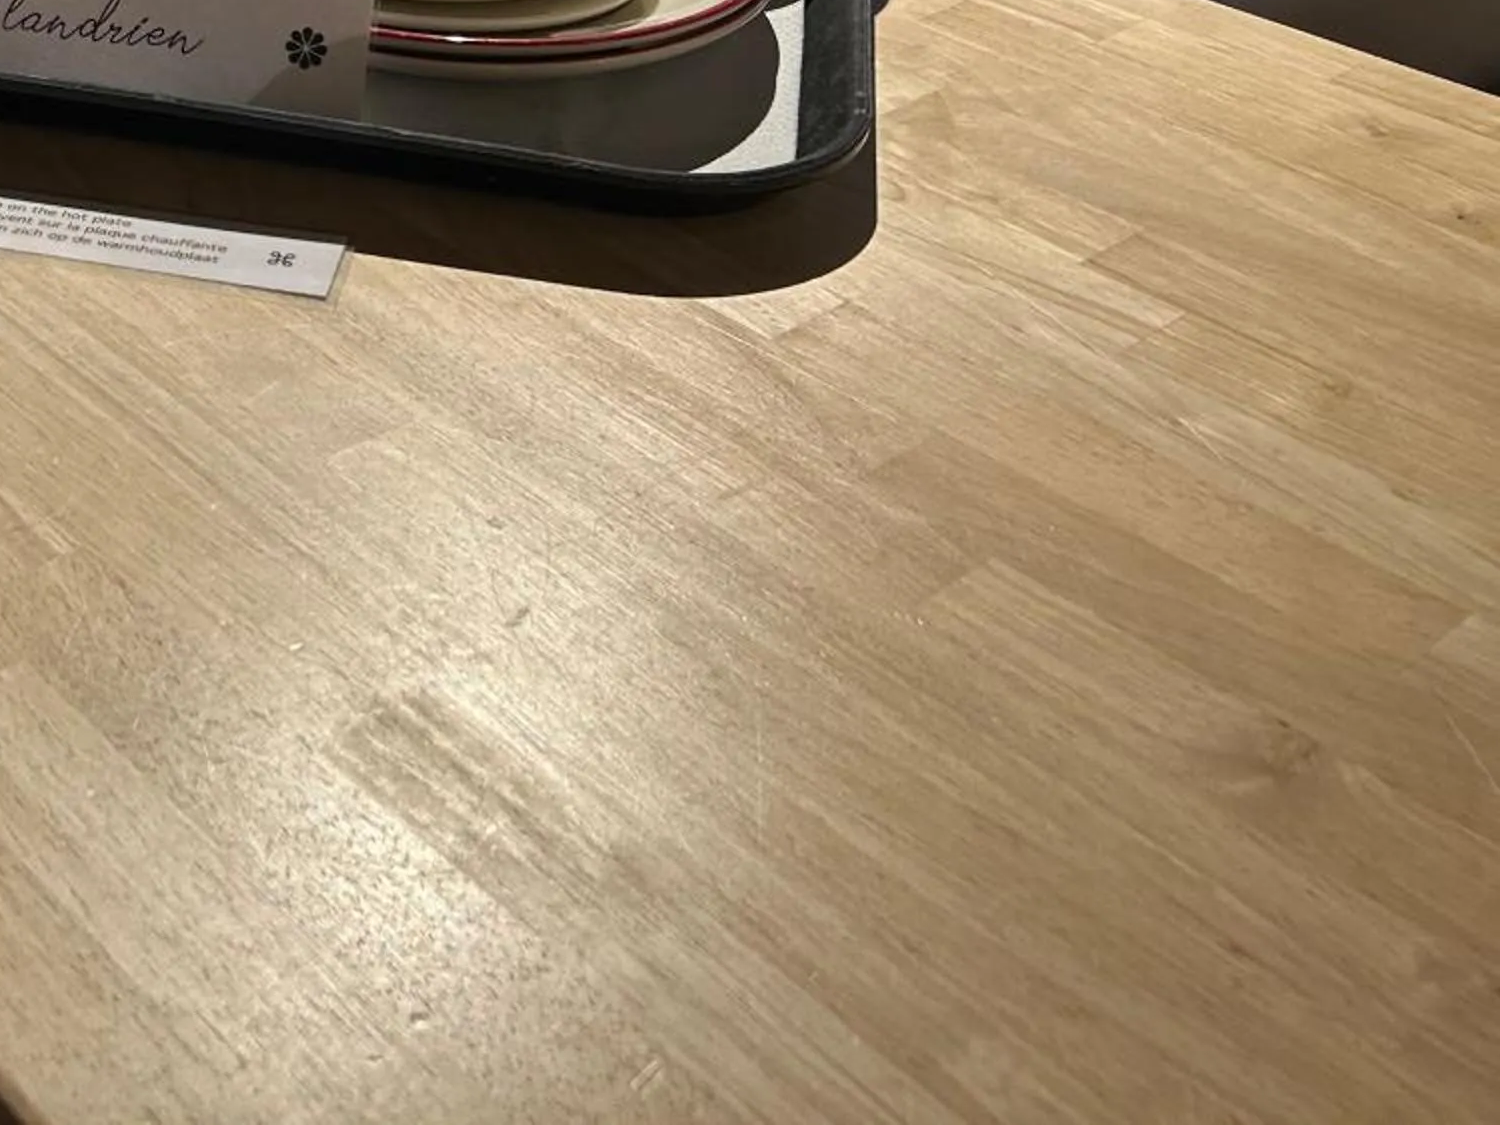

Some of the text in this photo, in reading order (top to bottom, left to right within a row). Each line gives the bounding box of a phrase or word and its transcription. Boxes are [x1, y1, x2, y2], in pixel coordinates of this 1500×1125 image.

[7, 204, 28, 213] on
[32, 204, 58, 217] the
[61, 209, 88, 222] hot
[91, 215, 132, 227] plate
[11, 227, 43, 238] zich
[48, 233, 68, 243] op
[72, 236, 92, 245] de
[97, 239, 220, 265] warmhoudplaat
[38, 218, 64, 229] sur
[67, 221, 81, 232] la
[84, 225, 137, 241] plaque
[141, 233, 228, 254] chauffante
